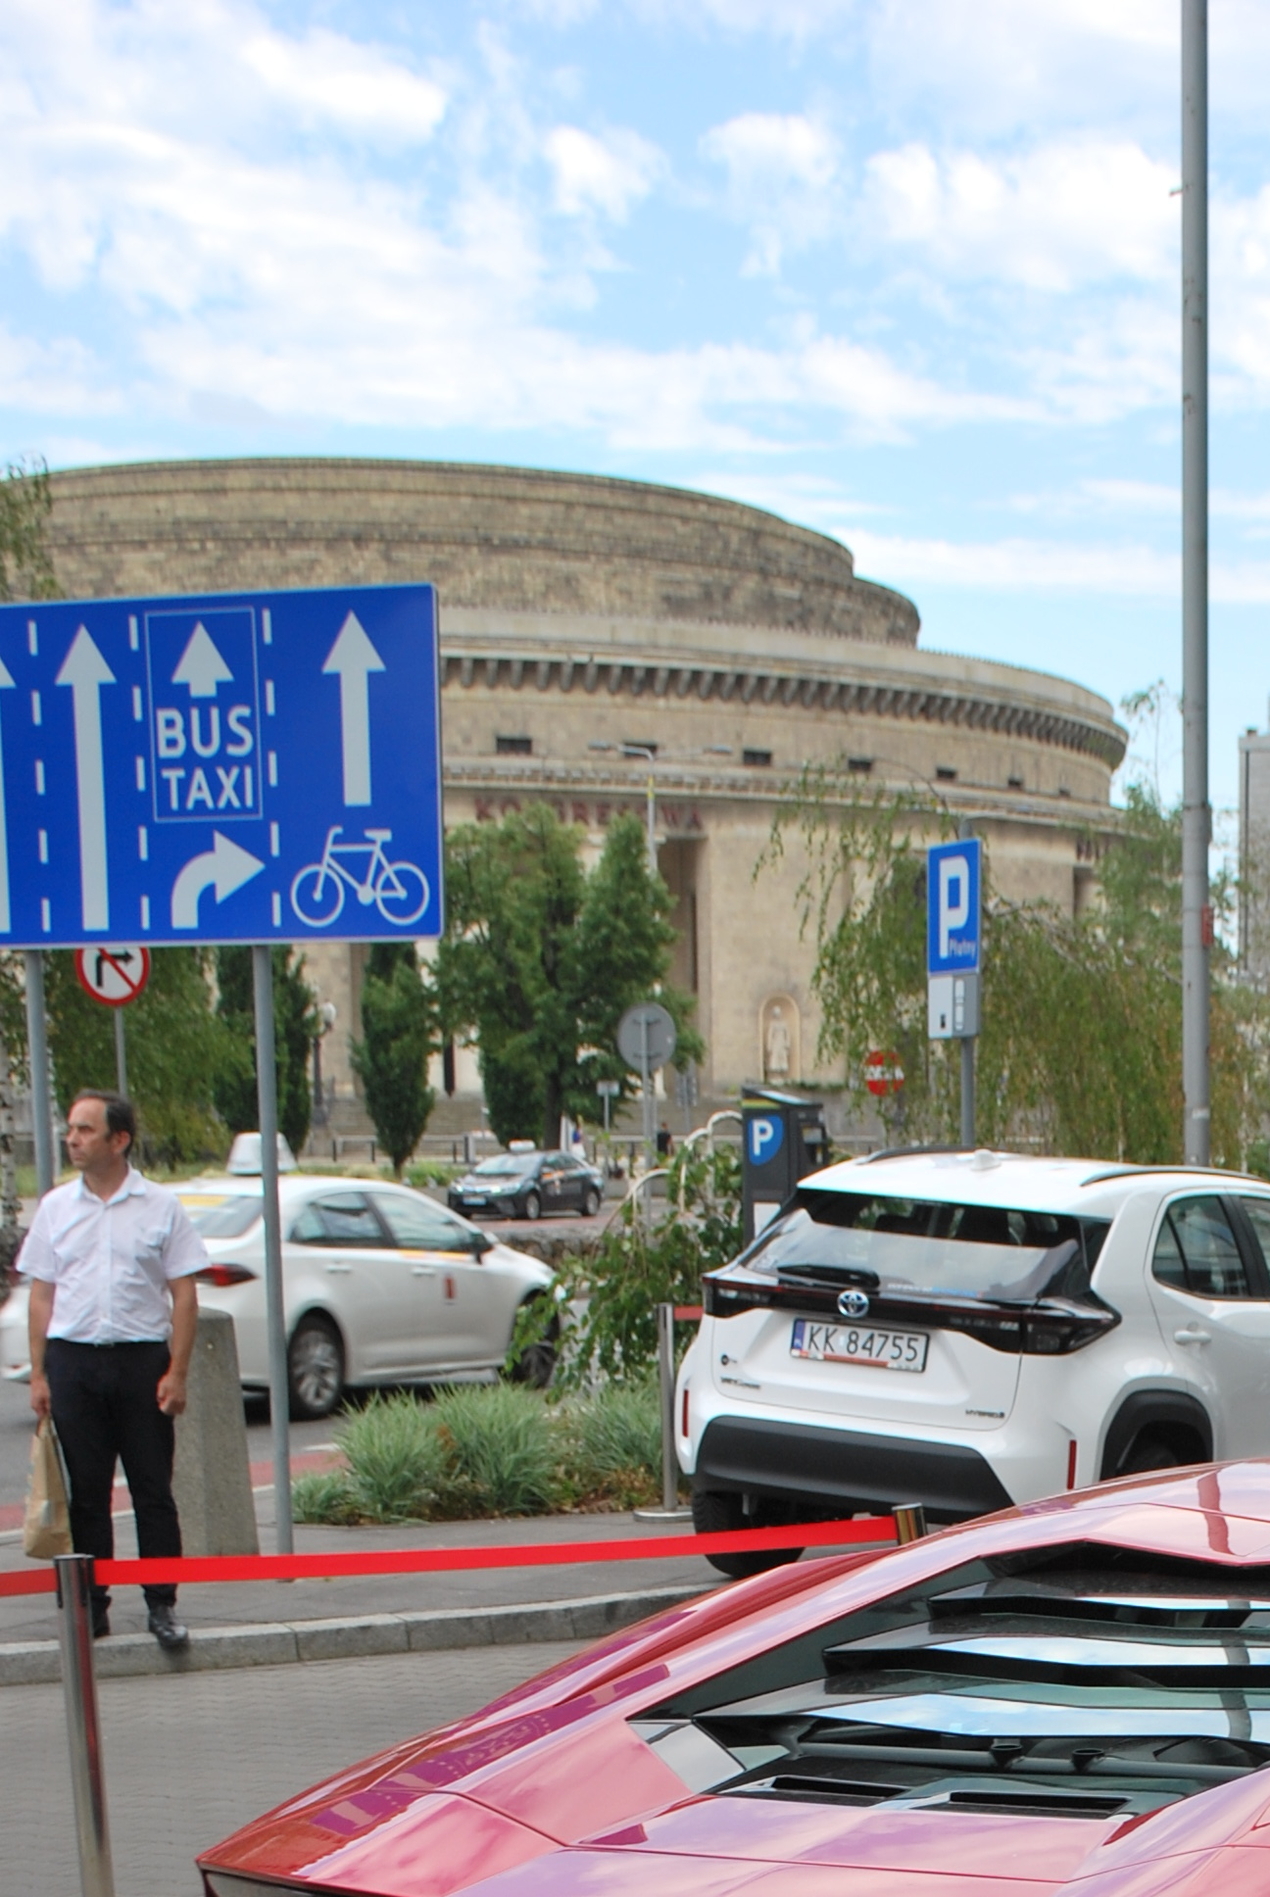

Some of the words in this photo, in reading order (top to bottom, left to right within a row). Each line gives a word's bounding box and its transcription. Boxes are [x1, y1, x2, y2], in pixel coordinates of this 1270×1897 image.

[156, 705, 254, 759] BUS
[161, 765, 254, 811] TAXI
[939, 856, 969, 959] P
[752, 1119, 774, 1157] P
[808, 1326, 837, 1353] KK
[846, 1331, 919, 1362] 84755
